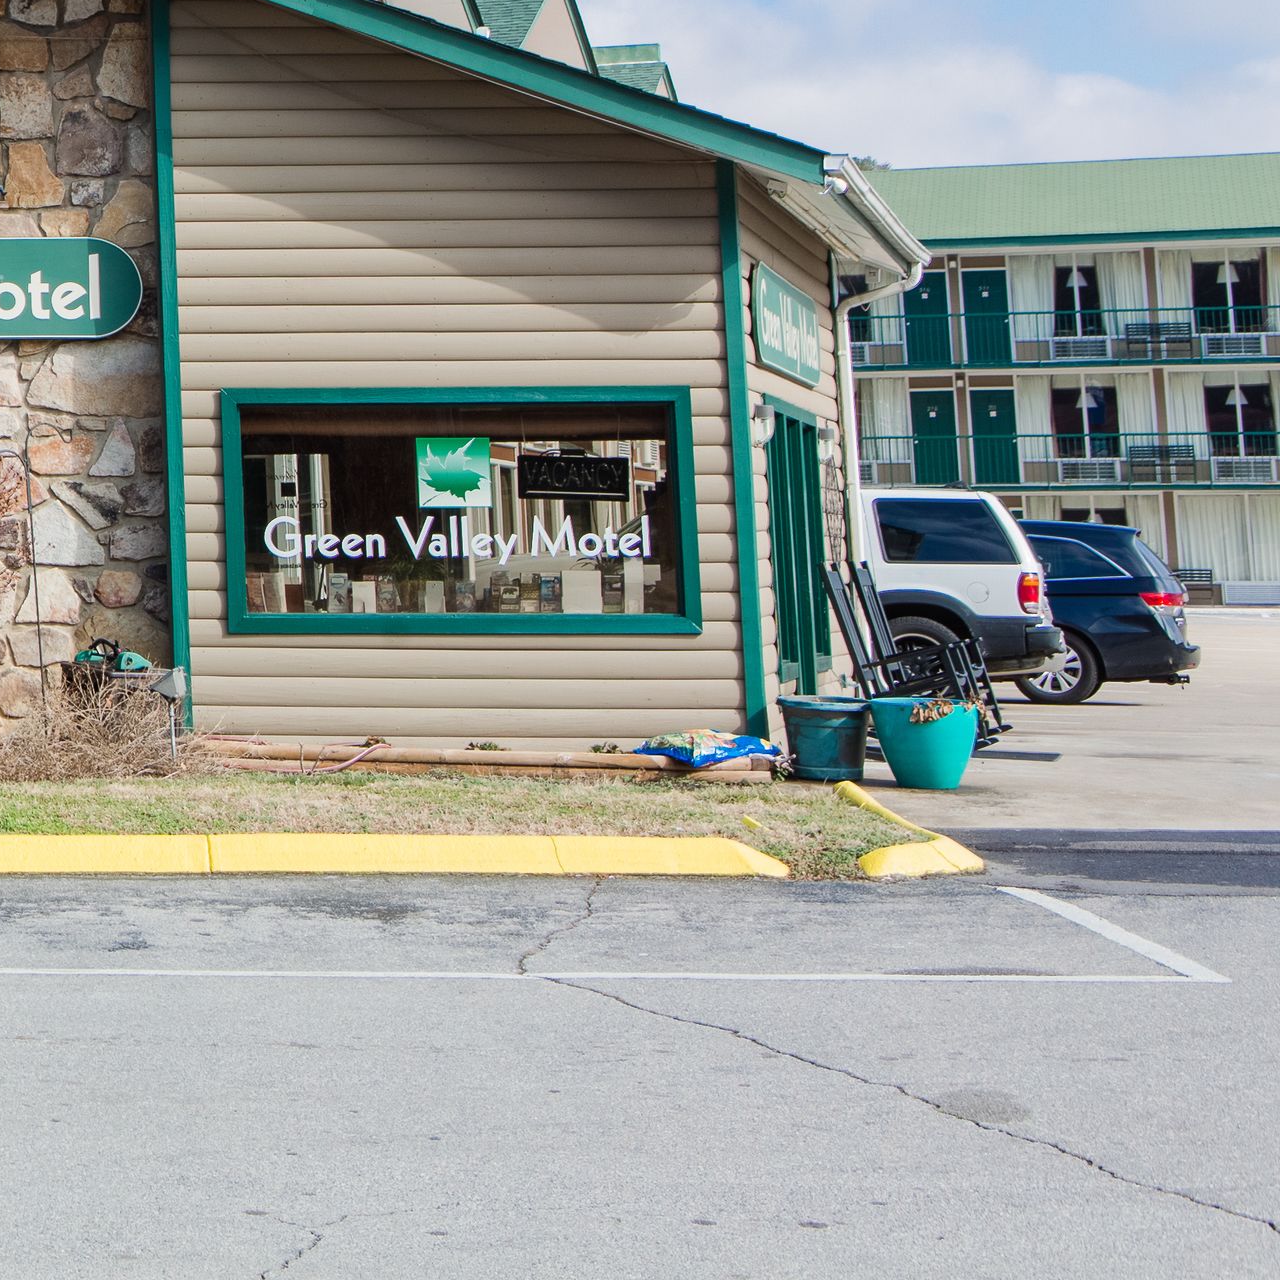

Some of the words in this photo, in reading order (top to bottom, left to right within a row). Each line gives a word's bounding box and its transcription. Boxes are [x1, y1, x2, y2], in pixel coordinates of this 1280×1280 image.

[760, 278, 783, 352] Green
[779, 292, 800, 374] Valley
[798, 303, 819, 370] Motel
[524, 461, 623, 489] VACANCY
[263, 515, 386, 558] Green
[395, 515, 518, 566] Valley
[530, 515, 652, 558] Motel
